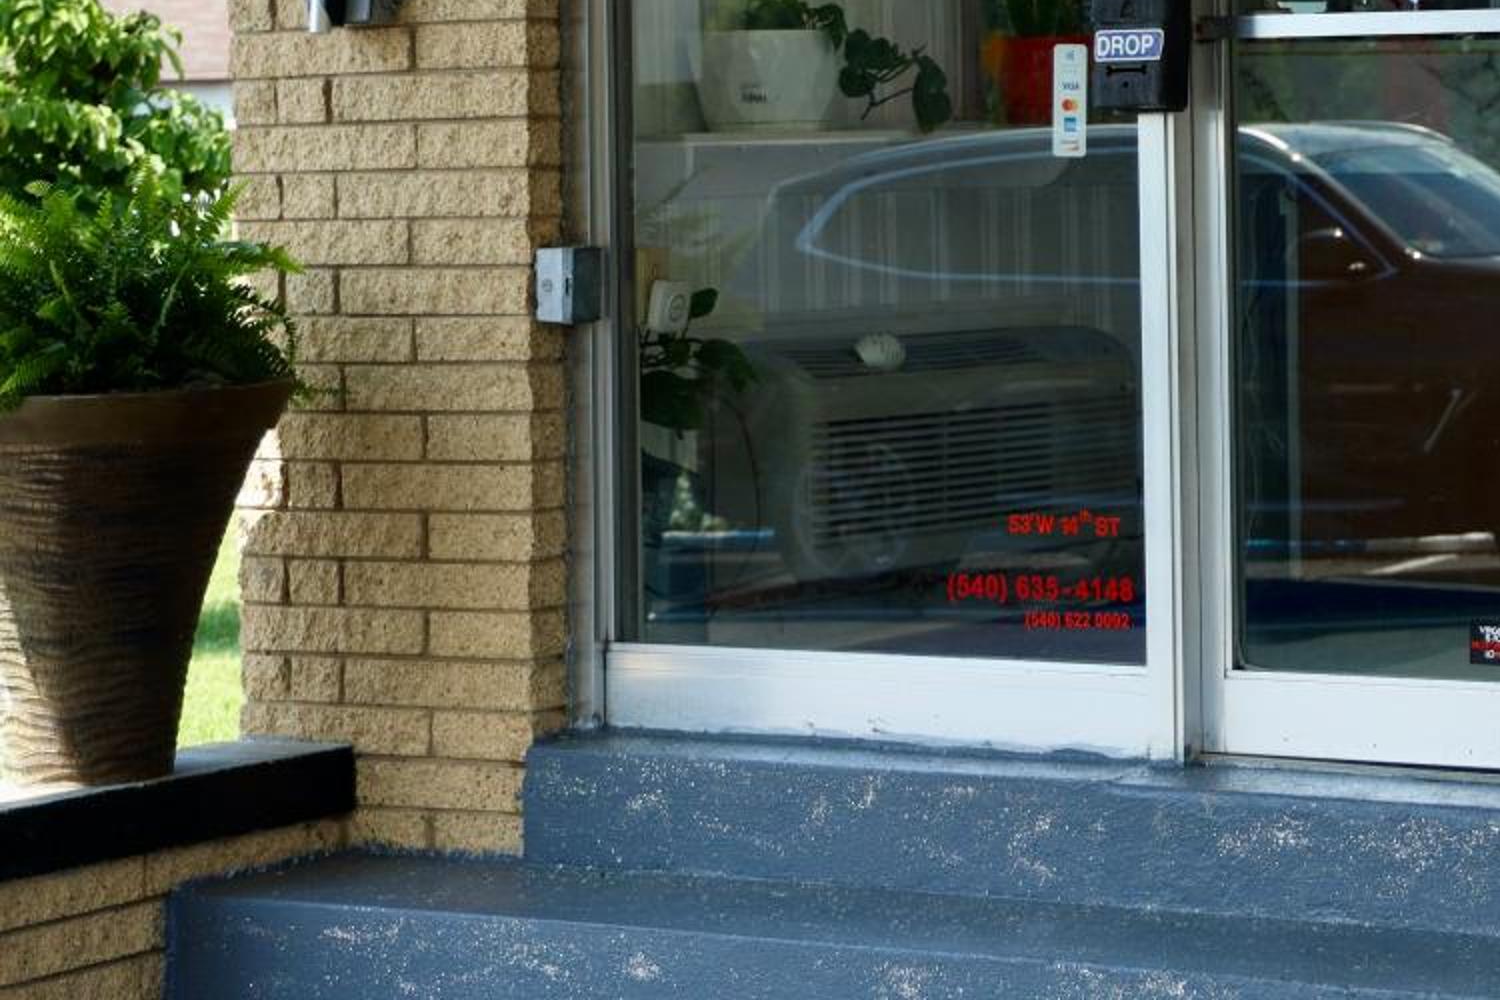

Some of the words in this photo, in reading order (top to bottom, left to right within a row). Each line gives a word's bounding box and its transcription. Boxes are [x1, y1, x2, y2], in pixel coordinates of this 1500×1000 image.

[1097, 35, 1155, 57] DROP
[947, 573, 1008, 604] (540)
[1015, 574, 1134, 603] 635-4148
